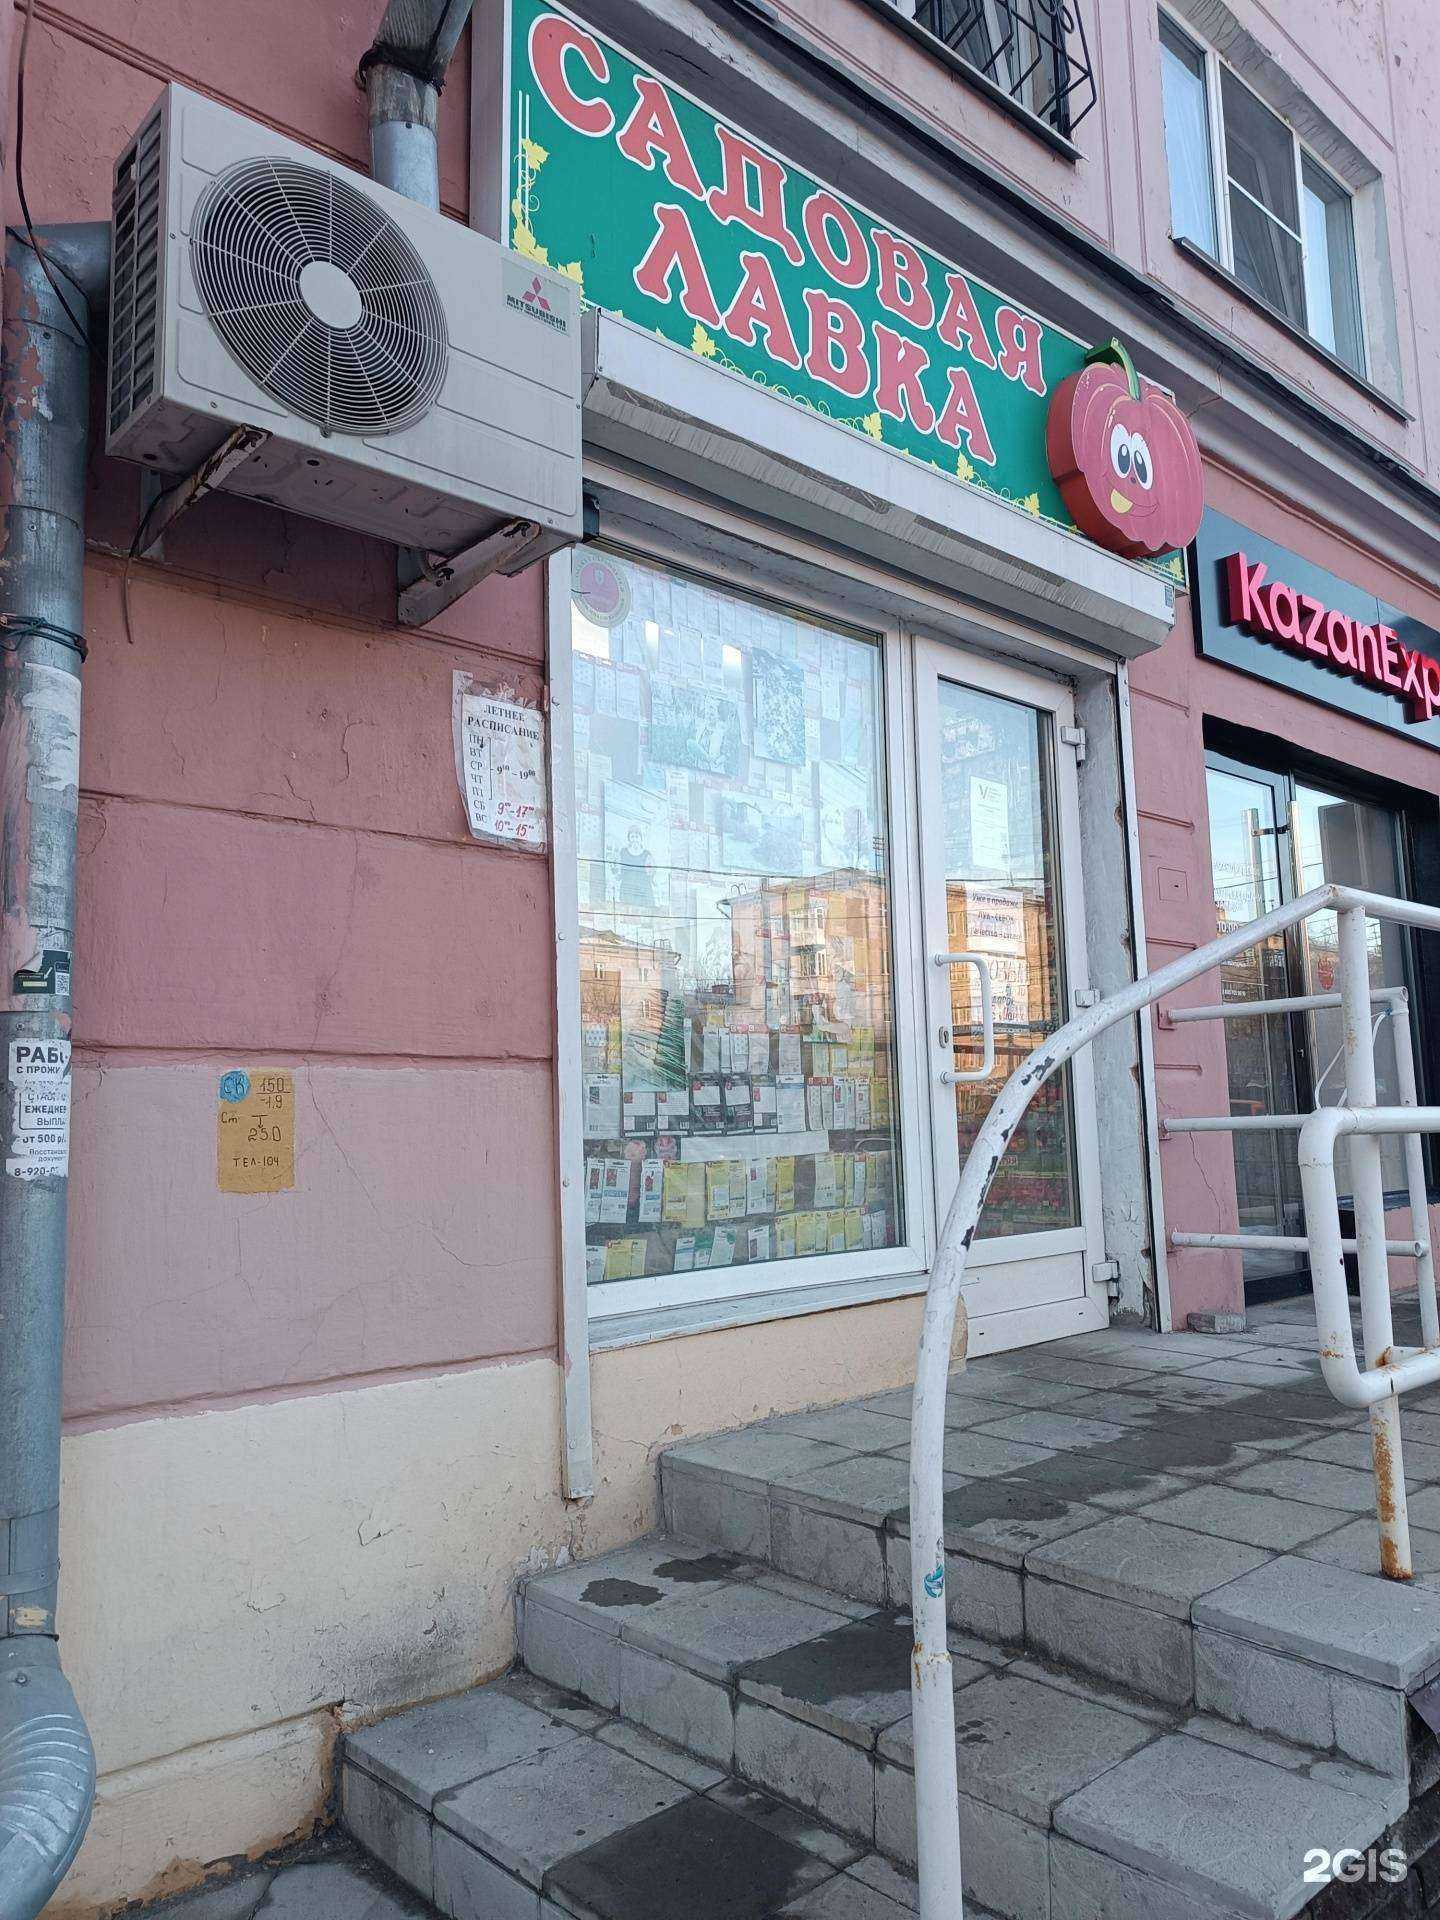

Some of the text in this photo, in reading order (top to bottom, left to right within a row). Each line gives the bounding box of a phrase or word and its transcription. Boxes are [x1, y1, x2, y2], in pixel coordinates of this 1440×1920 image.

[528, 13, 1047, 396] САДОВАЯ
[506, 294, 567, 328] MITSUBISHI
[634, 203, 997, 467] ЛАВКА
[484, 704, 525, 722] ЛЕТНЕЕ
[467, 716, 540, 741] РАСПИСАНИЕ
[469, 733, 484, 746] ПН
[469, 747, 482, 758] ВТ
[470, 760, 483, 771] СР
[471, 773, 483, 784] ЧТ
[473, 799, 486, 811] СБ
[475, 812, 488, 823] ВС
[37, 1133, 56, 1143] 500
[247, 1126, 282, 1142] 250
